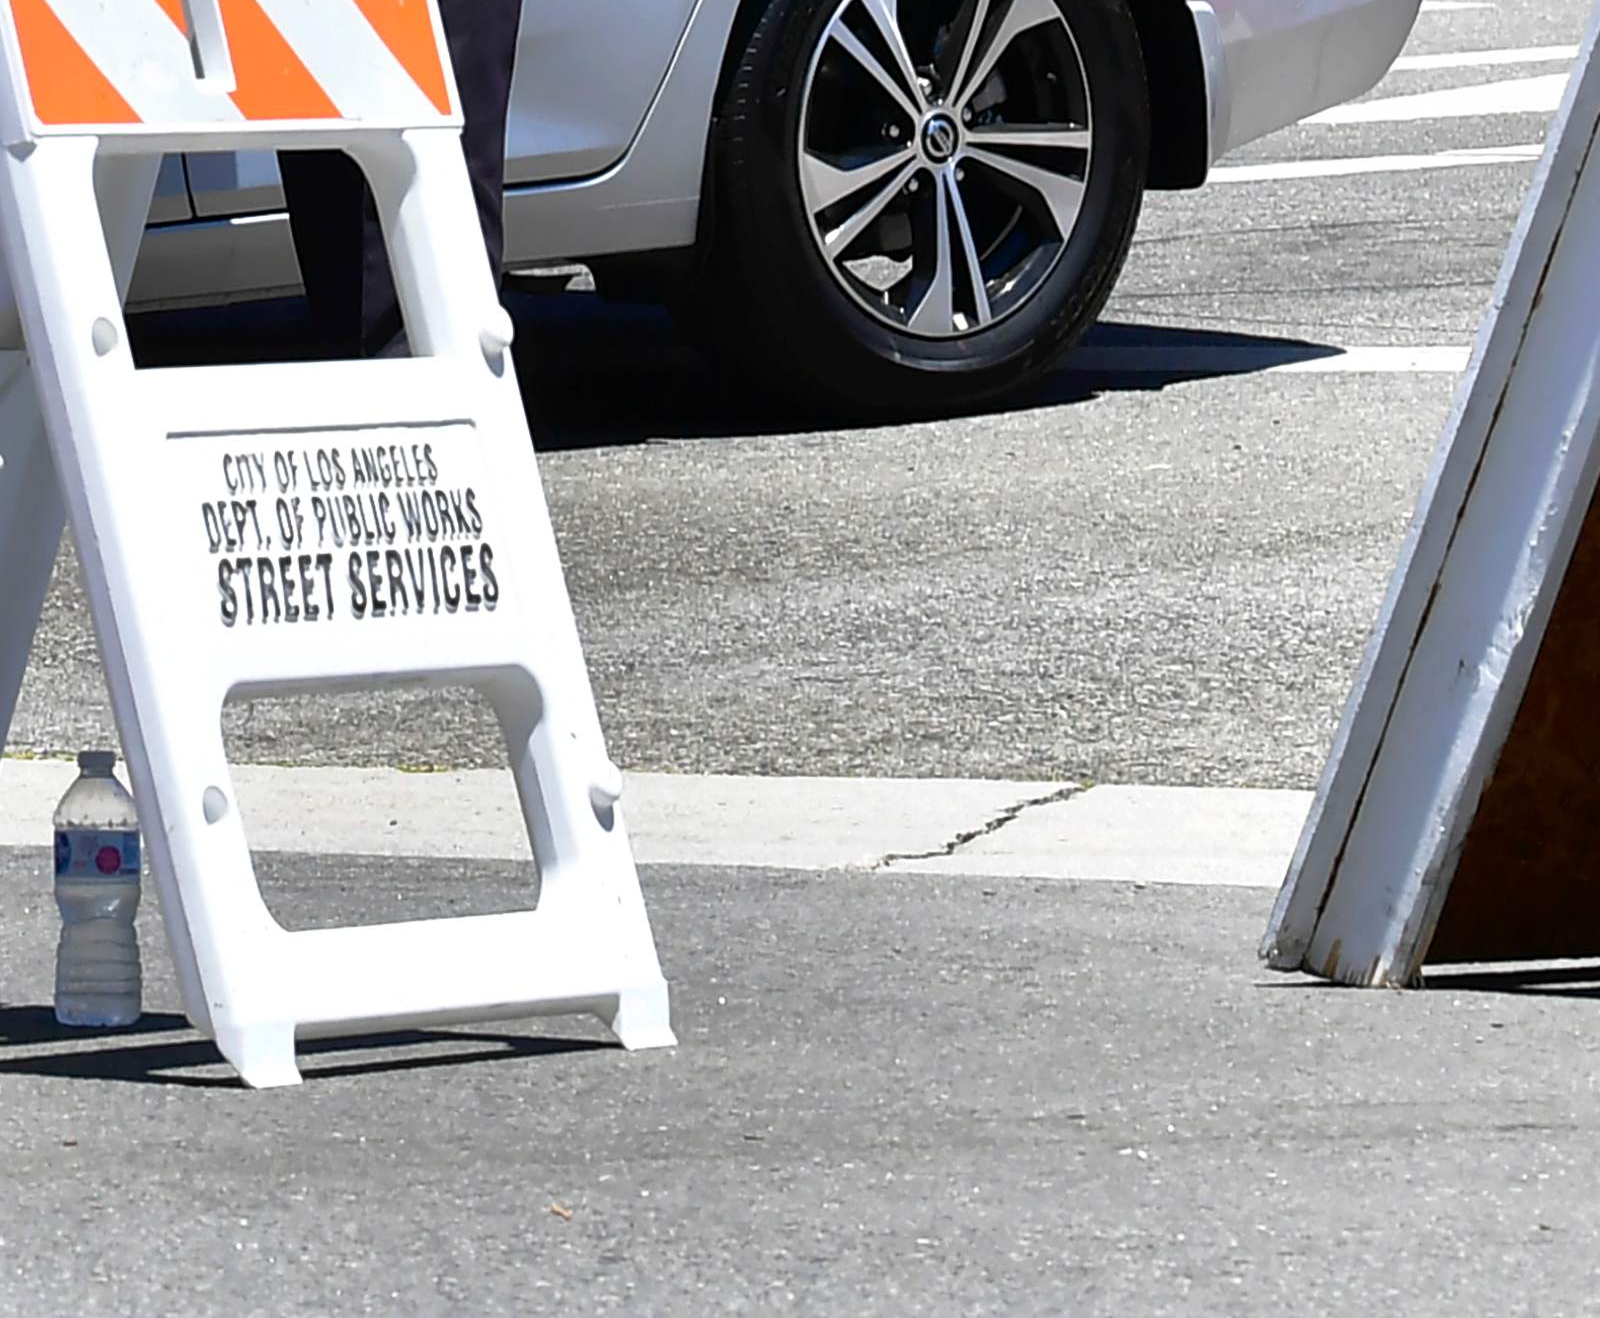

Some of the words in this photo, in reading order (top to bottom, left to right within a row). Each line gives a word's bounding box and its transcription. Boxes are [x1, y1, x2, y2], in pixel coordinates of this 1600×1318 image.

[222, 452, 267, 496] CITY
[273, 450, 297, 494] OF
[303, 448, 346, 492] LOS
[351, 443, 438, 489] ANGELES
[202, 499, 271, 554] DEPT.
[276, 497, 304, 551] OF
[311, 491, 396, 548] PUBLIC
[396, 487, 483, 543] WORKS
[217, 552, 335, 628] STREET
[348, 542, 500, 620] SERVICES
